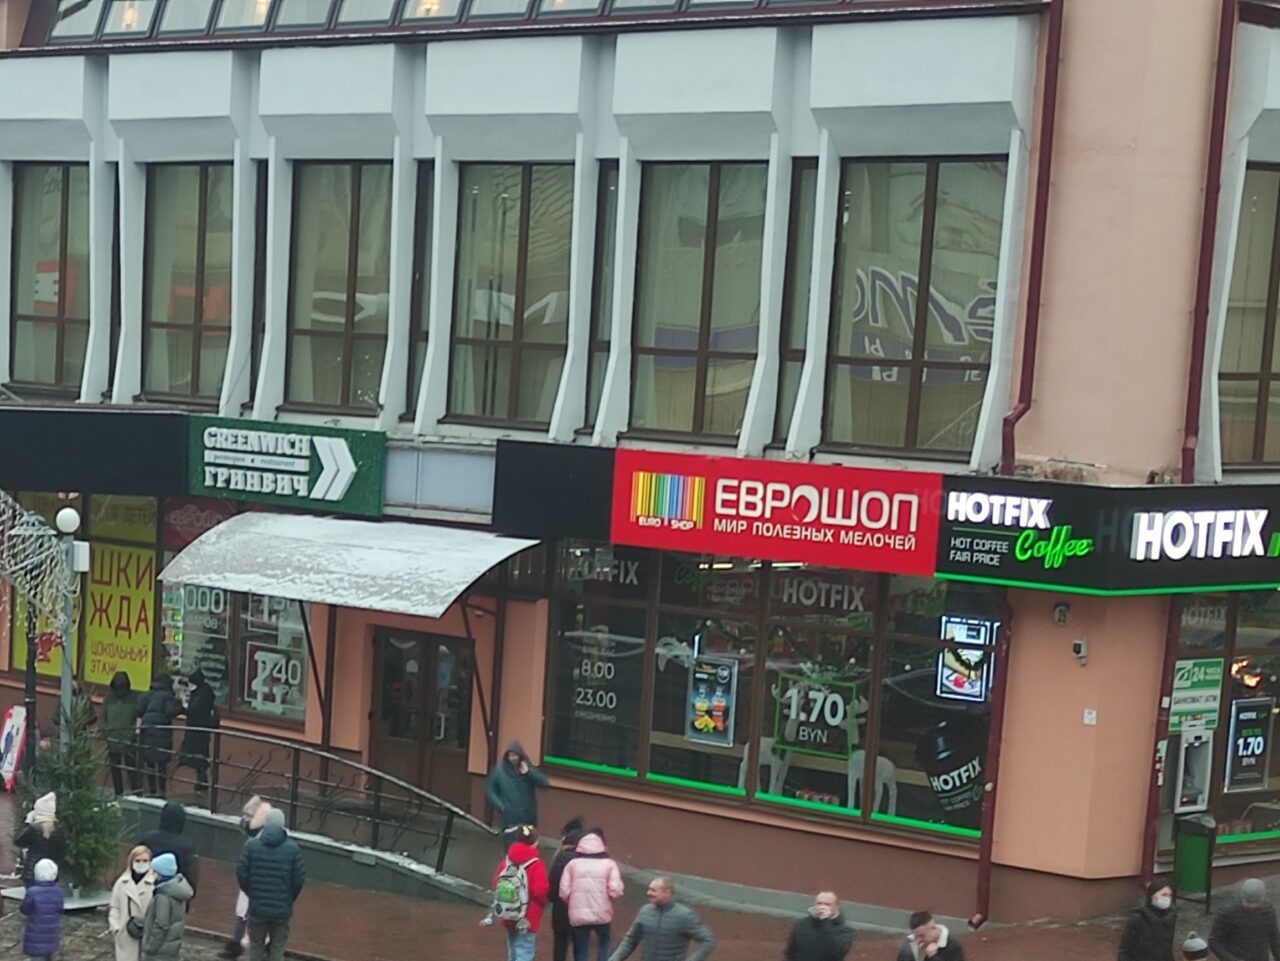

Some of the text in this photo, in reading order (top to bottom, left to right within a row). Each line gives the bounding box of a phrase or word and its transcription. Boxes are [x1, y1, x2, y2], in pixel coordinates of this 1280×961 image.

[204, 427, 311, 456] GREENWICH
[204, 466, 309, 497] ГРИНВИЧ
[715, 478, 919, 532] ЕВРОШОП
[947, 491, 1052, 529] HOTFIX
[638, 516, 694, 531] EURO SHOP
[714, 520, 916, 551] МИР ПОЛЕЗНЫХ МЕЛОЧЕЙ
[1131, 509, 1269, 560] HOTFIX
[949, 550, 1001, 566] FAIR PRICE
[951, 537, 1009, 553] HOT COFFEE
[1015, 525, 1093, 568] Coffee
[783, 578, 864, 611] HOTFIX
[91, 641, 148, 663] ЦОКОЛЬНЫЙ
[91, 659, 117, 675] ЭТАЖ
[581, 659, 615, 680] 8.00
[575, 687, 617, 709] 23.00
[782, 688, 844, 726] 1.70
[799, 726, 828, 743] BYN
[1237, 736, 1264, 756] 1.70
[930, 756, 981, 791] HOTFIX
